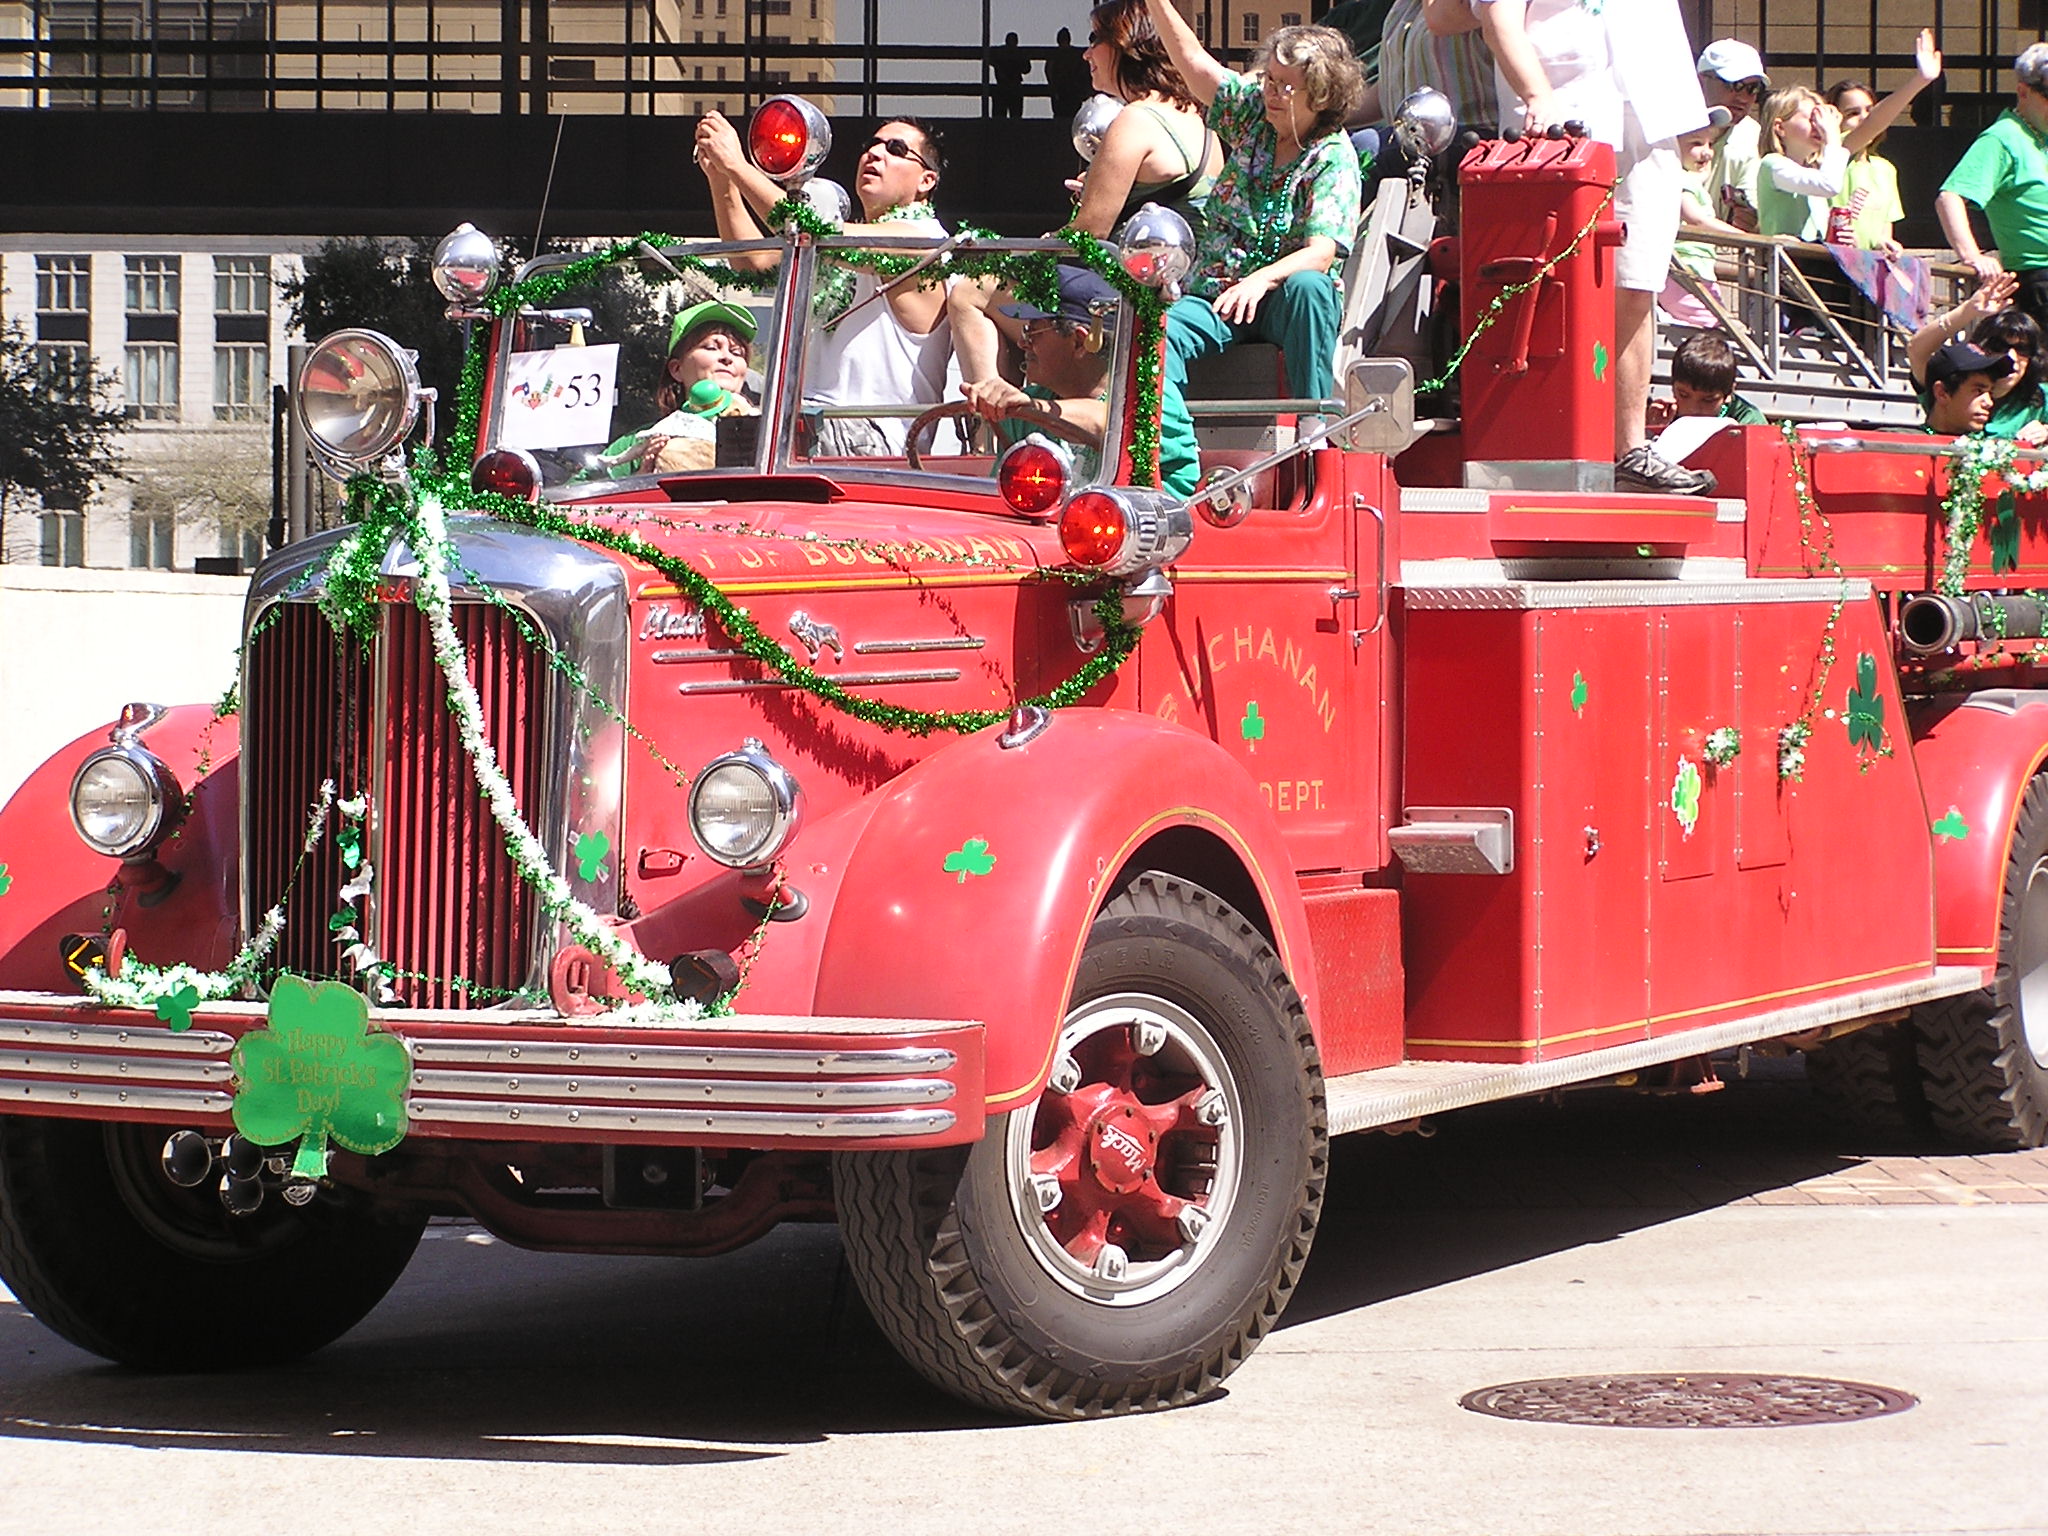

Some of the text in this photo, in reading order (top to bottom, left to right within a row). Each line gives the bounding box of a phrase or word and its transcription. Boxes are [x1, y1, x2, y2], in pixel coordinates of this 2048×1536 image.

[564, 373, 602, 409] 53
[1155, 624, 1336, 733] BUCHANAN
[287, 1026, 348, 1057] Happy
[289, 1058, 377, 1090] Patrick's
[296, 1086, 342, 1117] Day!
[1099, 1124, 1147, 1174] Mack
